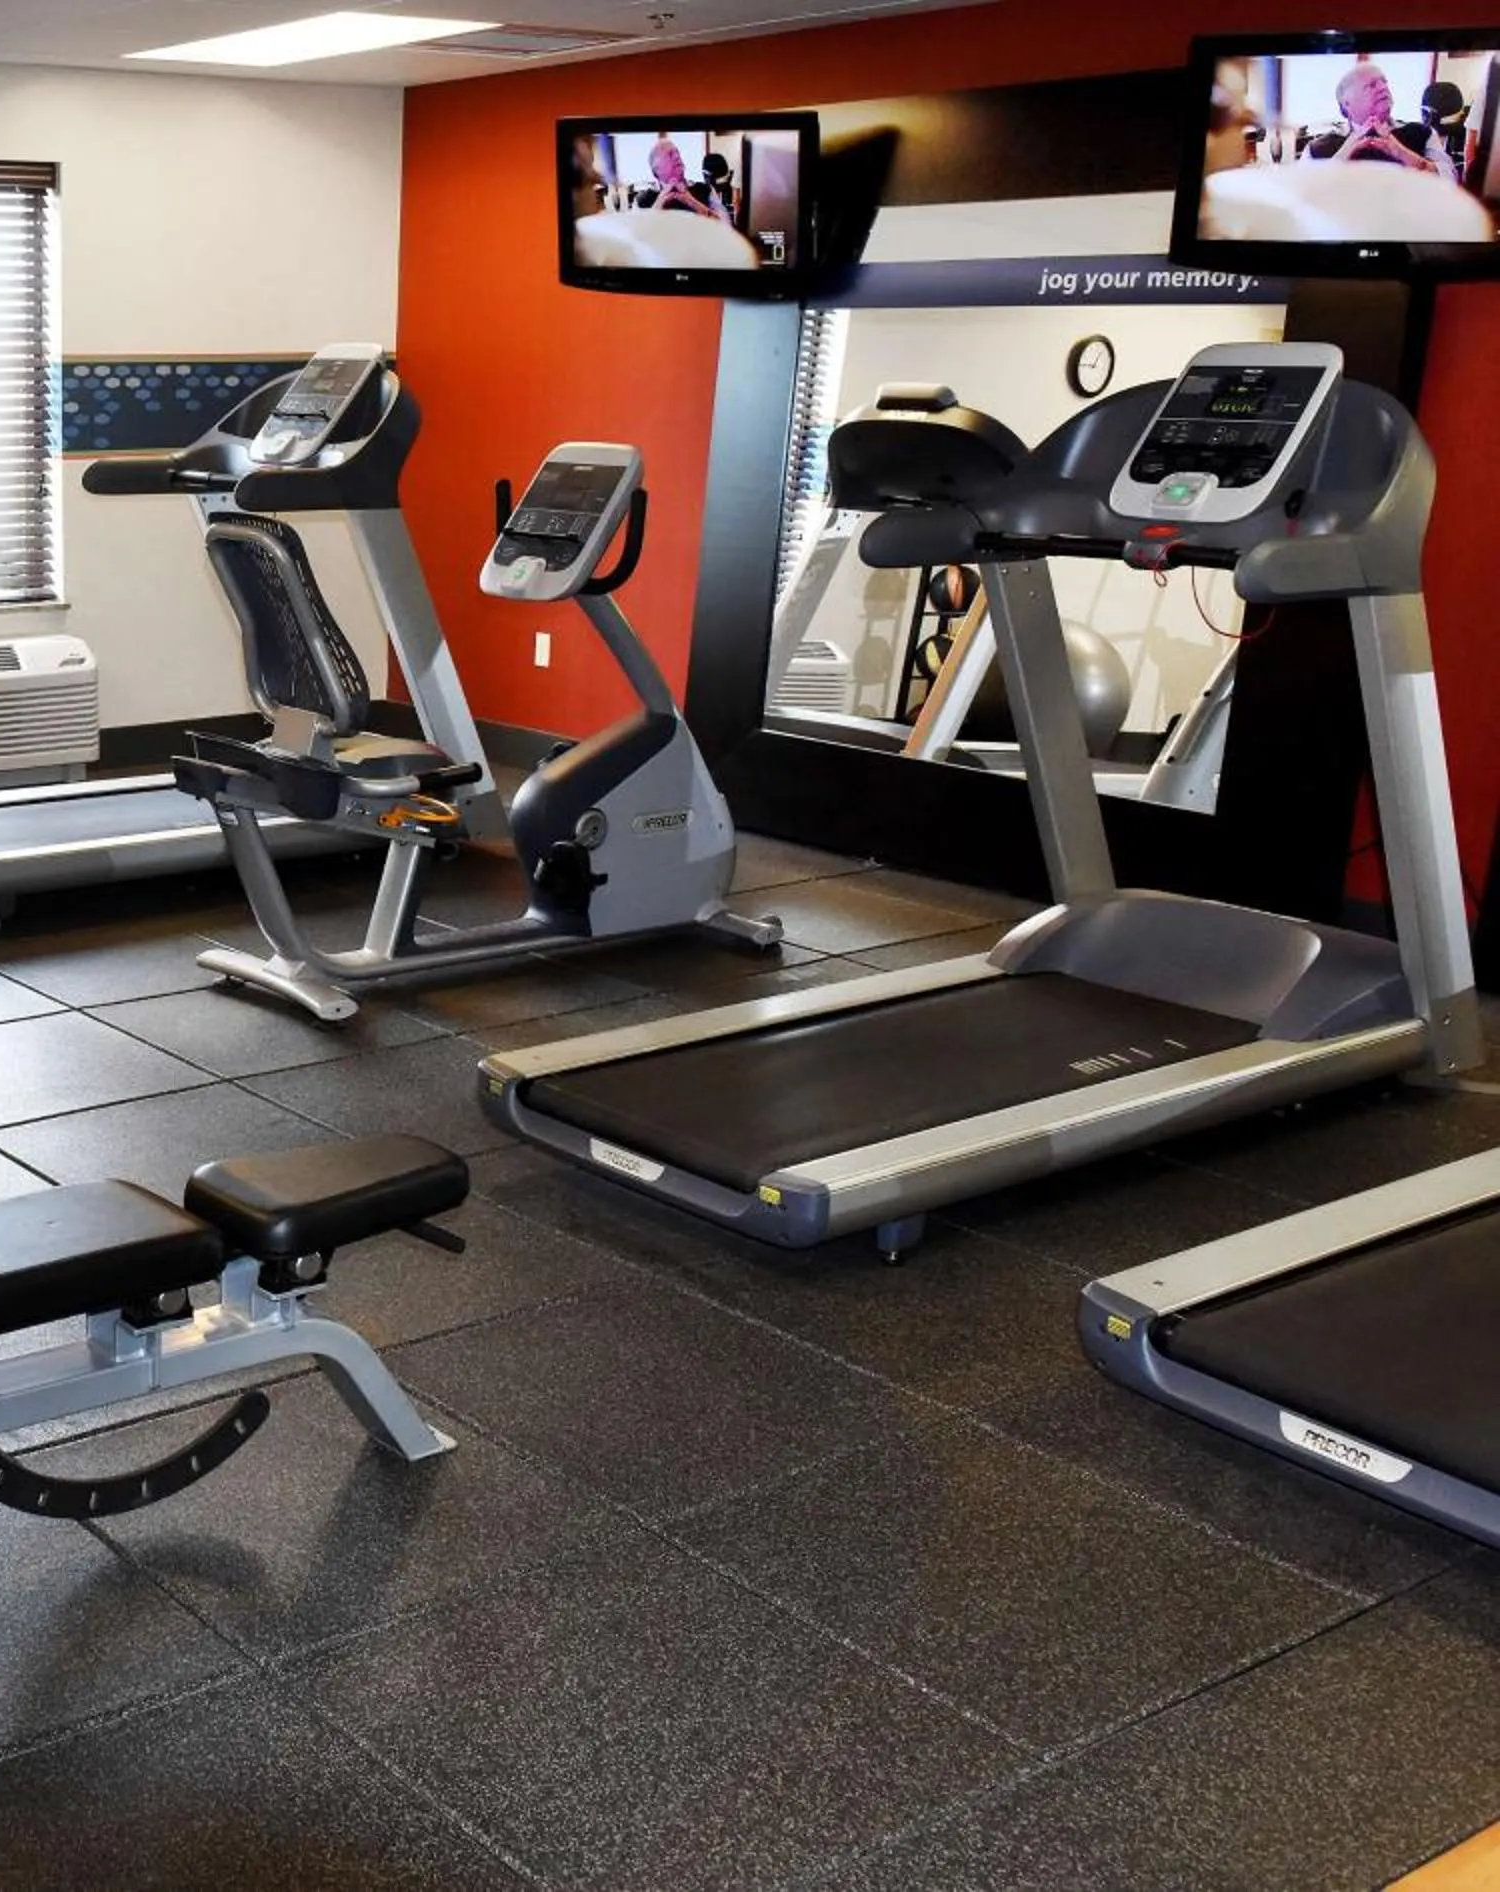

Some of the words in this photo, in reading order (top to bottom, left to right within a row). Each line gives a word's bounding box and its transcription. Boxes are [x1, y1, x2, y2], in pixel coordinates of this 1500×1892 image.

[1038, 268, 1077, 295] jog
[1084, 271, 1140, 294] your
[1147, 270, 1259, 293] memory.
[1304, 1429, 1371, 1469] PRECOR
